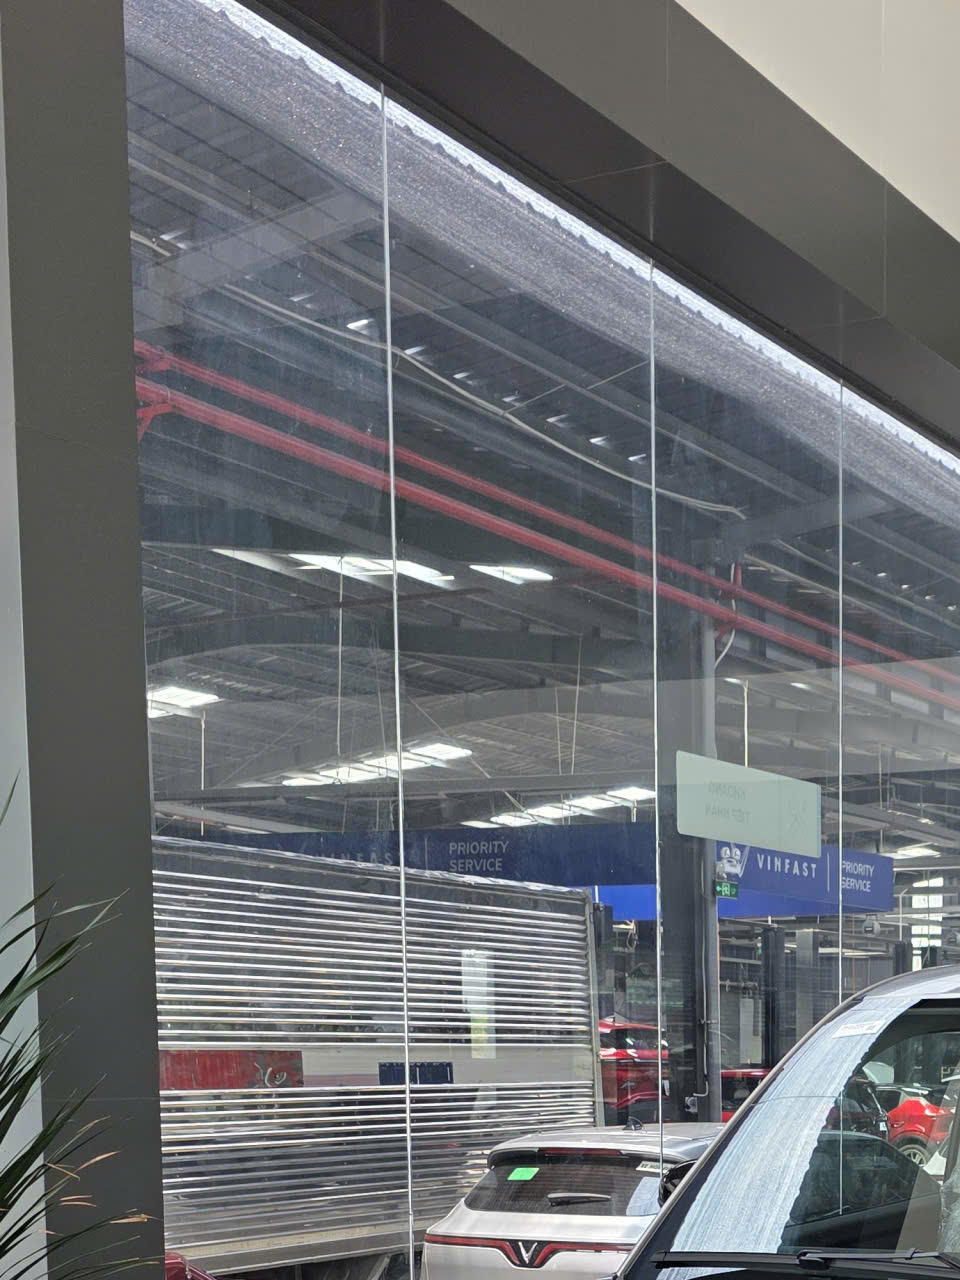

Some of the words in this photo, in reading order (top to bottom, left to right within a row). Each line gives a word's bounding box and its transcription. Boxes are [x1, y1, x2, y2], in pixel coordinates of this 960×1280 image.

[448, 841, 509, 855] PRIORITY
[449, 858, 503, 872] SERVICE
[756, 852, 817, 878] VINFAST
[841, 860, 875, 878] PRIORITY
[841, 876, 871, 892] SERVICE
